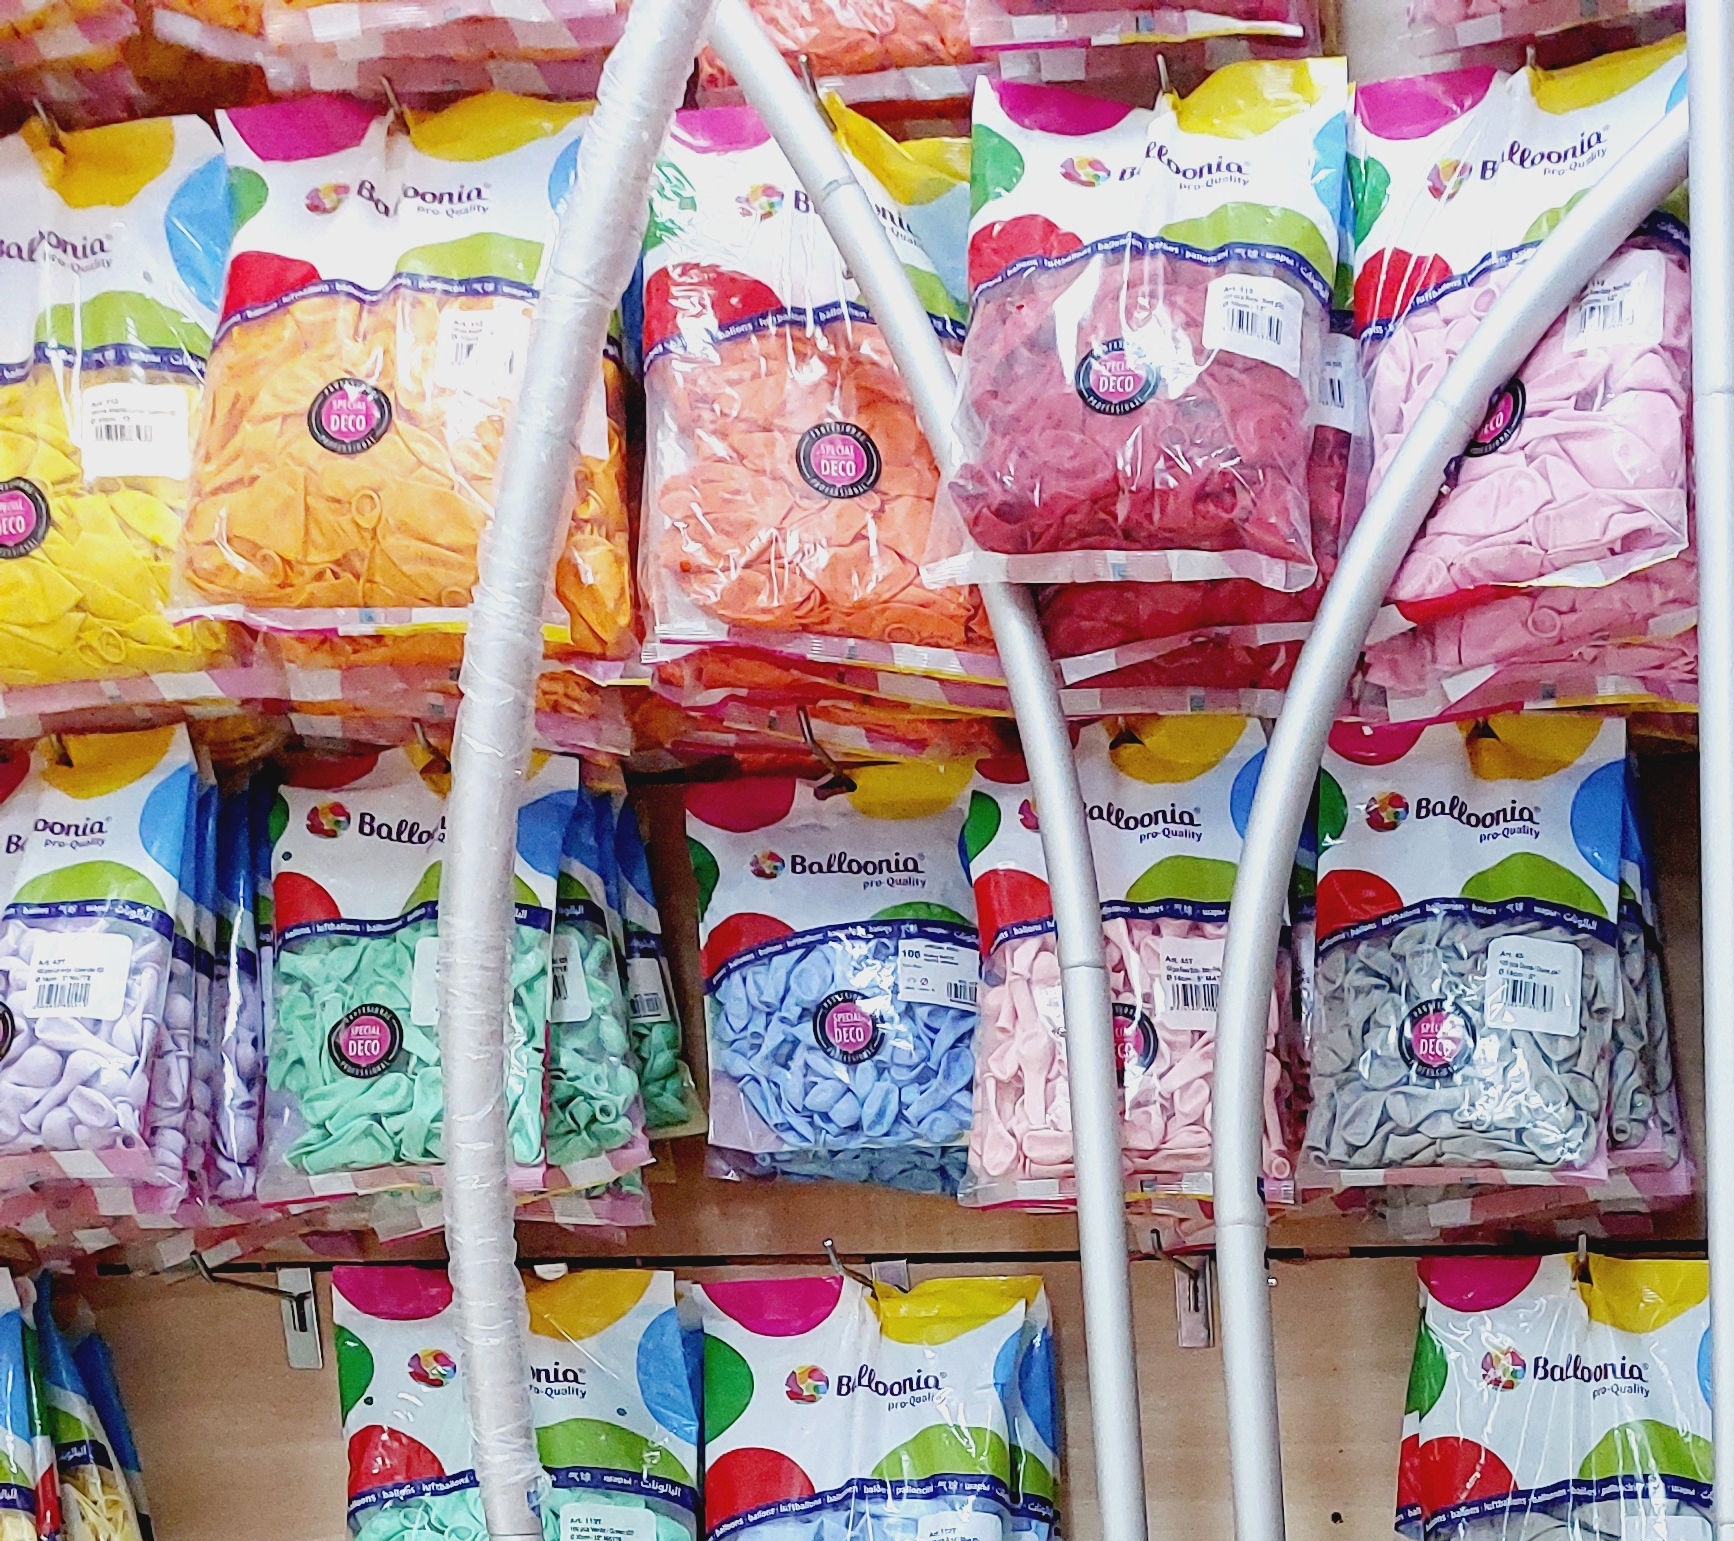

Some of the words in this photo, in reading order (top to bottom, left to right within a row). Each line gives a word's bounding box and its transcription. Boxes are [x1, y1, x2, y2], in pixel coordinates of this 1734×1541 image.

[1098, 373, 1135, 393] DECO
[330, 413, 367, 433] DECO
[817, 443, 856, 458] SPECIAL
[819, 458, 856, 478] DECO
[1085, 802, 1202, 831] alloonia
[1415, 795, 1541, 829] Balloonia
[1139, 827, 1203, 844] pro-Quality
[1479, 825, 1540, 844] pro-Quality
[790, 851, 925, 876] Balloonia
[863, 876, 927, 891] pro-Quality
[901, 949, 921, 960] 100
[350, 1026, 381, 1037] SPECIAL
[834, 1027, 864, 1044] DECO
[348, 1039, 381, 1057] DECO
[1533, 1354, 1649, 1383] Balloonia
[1591, 1382, 1651, 1400] pro-Quality
